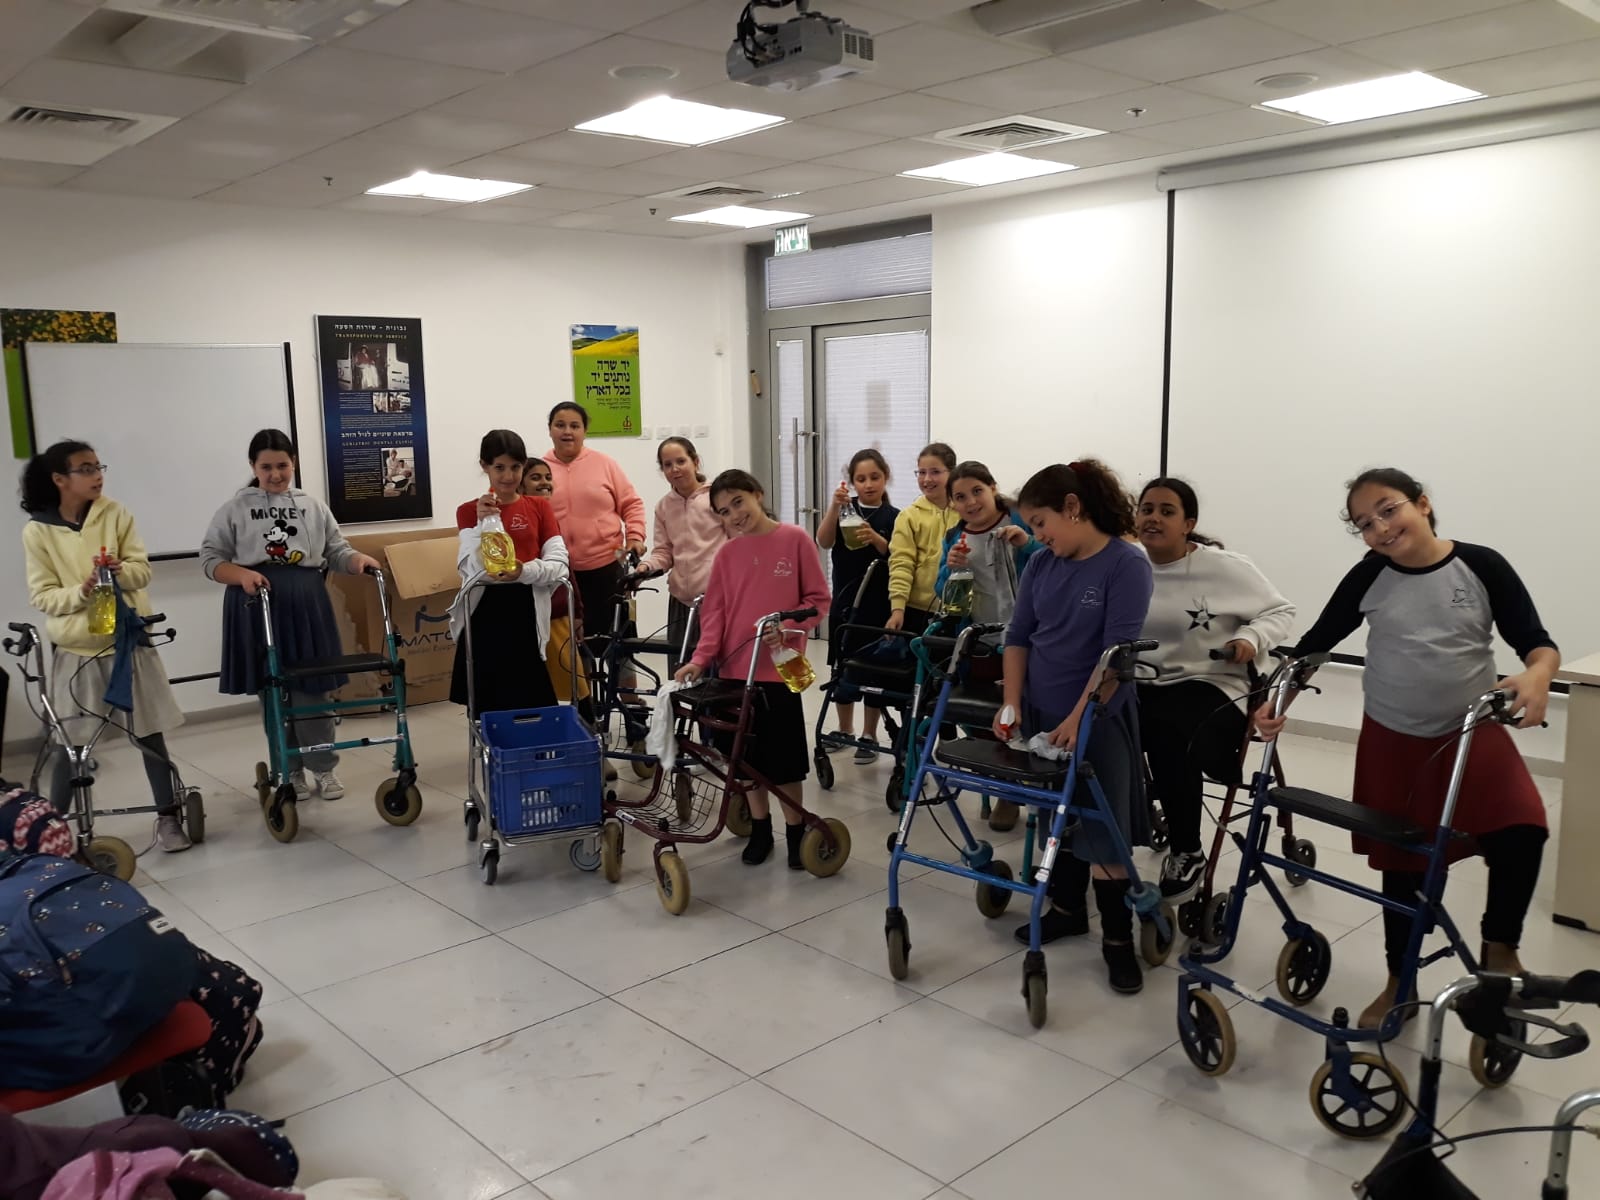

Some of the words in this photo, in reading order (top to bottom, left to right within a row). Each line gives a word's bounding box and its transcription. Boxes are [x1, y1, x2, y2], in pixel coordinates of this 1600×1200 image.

[775, 225, 809, 253] יציאה
[597, 360, 617, 371] שרה
[620, 360, 630, 370] יד
[591, 372, 600, 382] יד
[603, 372, 630, 382] נותנים
[586, 385, 611, 399] הארץ
[613, 383, 631, 395] בכל
[250, 506, 306, 520] MICKEY
